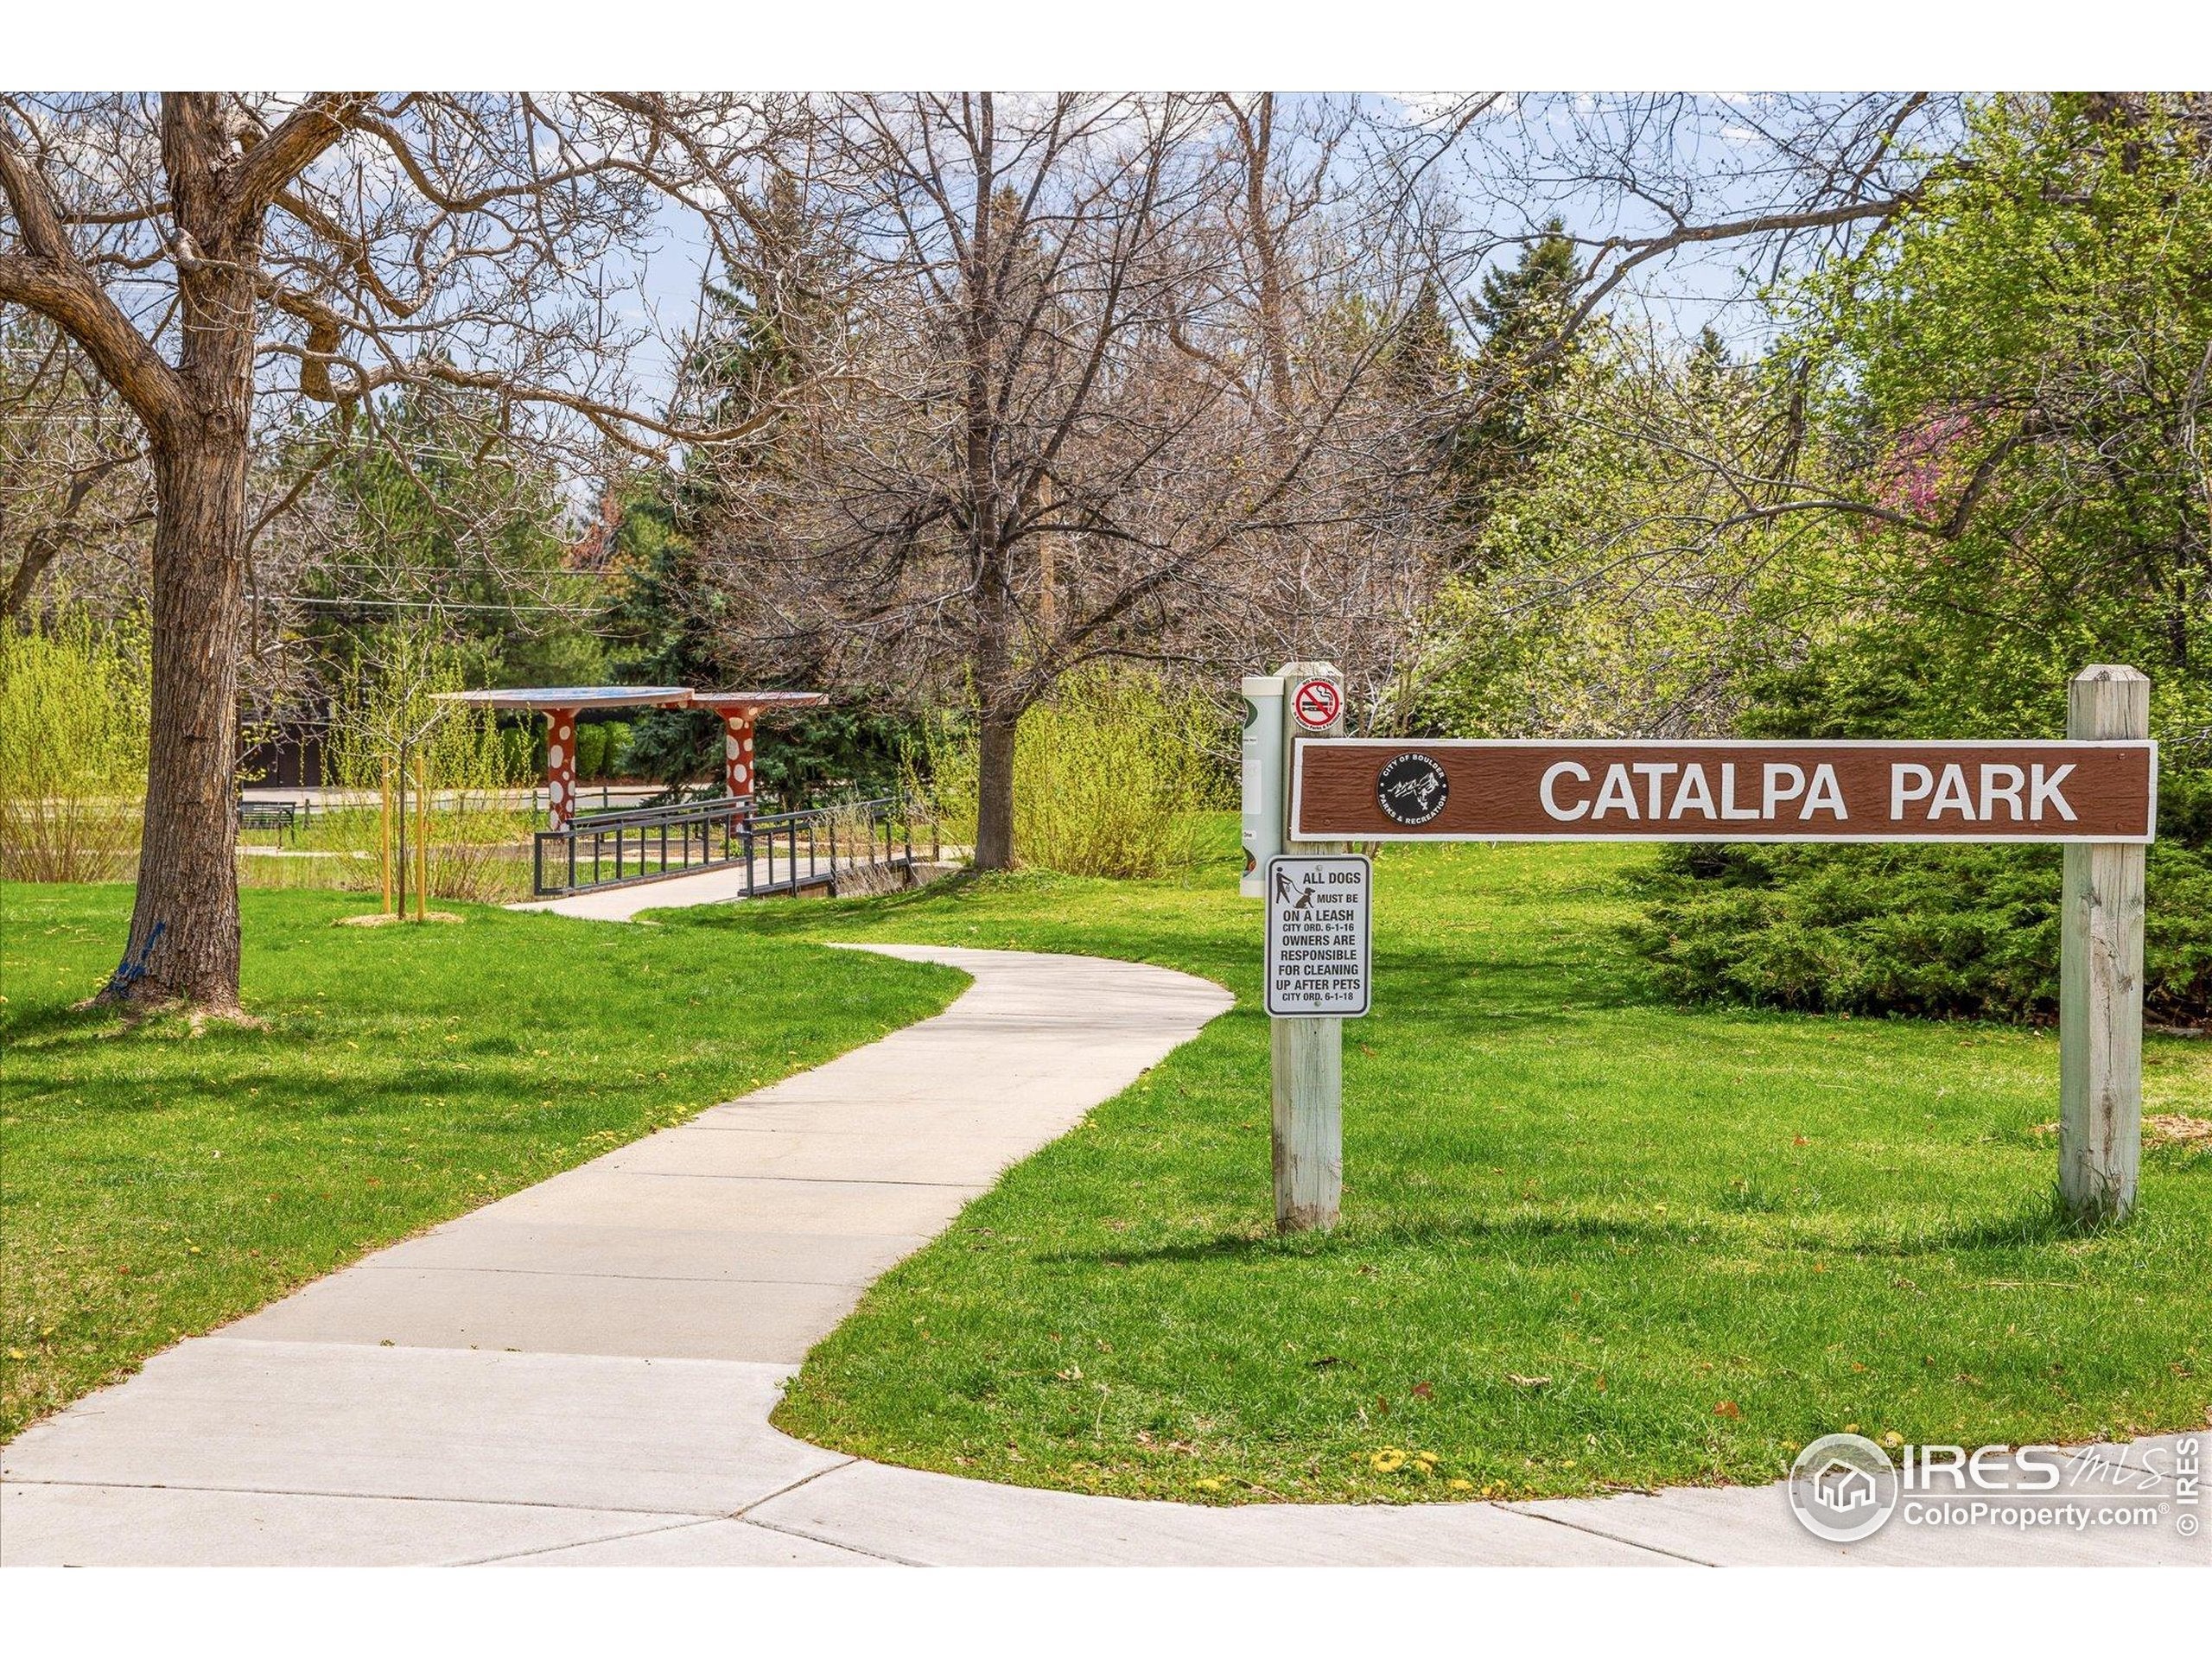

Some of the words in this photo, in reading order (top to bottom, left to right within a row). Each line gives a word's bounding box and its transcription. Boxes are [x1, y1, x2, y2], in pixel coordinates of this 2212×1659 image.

[1382, 760, 1398, 777] CITY
[1399, 754, 1410, 763] OF
[1412, 753, 1445, 779] BOULDER
[1540, 761, 1848, 823] CATALPA
[1891, 763, 2078, 822] PARK
[1379, 793, 1396, 818] PARKS
[1405, 794, 1447, 824] RECREATION
[1303, 873, 1325, 884] ALL
[1329, 873, 1362, 884] DOGS
[1317, 894, 1343, 903] MUST
[1345, 893, 1358, 903] BE
[1283, 910, 1300, 922] ON
[1303, 910, 1313, 922] A
[1316, 910, 1354, 921] LEASH
[1282, 924, 1301, 932] CITY
[1303, 923, 1324, 932] ORD.
[1325, 923, 1354, 931] 6-1-16
[1282, 935, 1330, 946] OWNERS
[1333, 935, 1356, 946] ARE
[1281, 950, 1357, 961] RESPONSIBLE
[1279, 964, 1300, 976] FOR
[1303, 964, 1358, 976] CLEANING
[1276, 979, 1291, 991] UP
[1294, 979, 1329, 990] AFTER
[1332, 979, 1360, 990] PETS
[1282, 992, 1301, 1001] CITY
[1303, 992, 1323, 1001] ORD.
[1325, 992, 1354, 1001] 6-1-18
